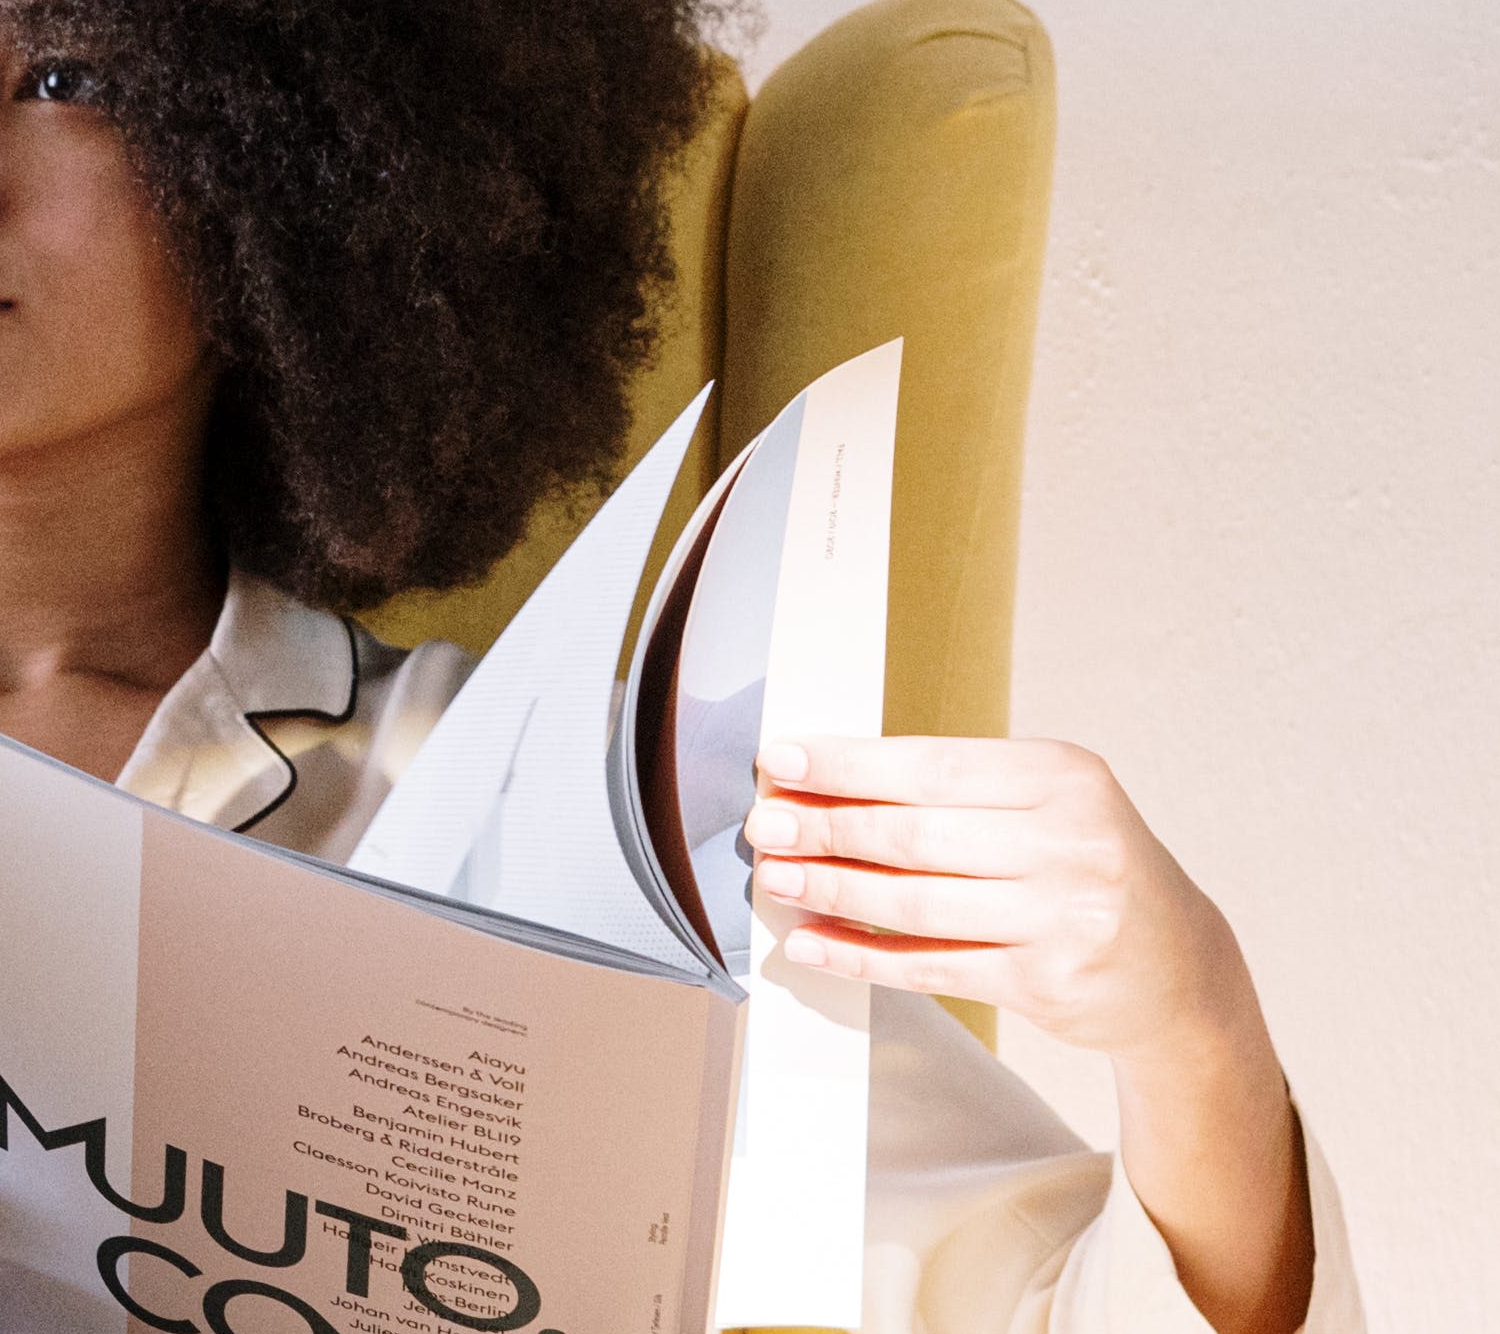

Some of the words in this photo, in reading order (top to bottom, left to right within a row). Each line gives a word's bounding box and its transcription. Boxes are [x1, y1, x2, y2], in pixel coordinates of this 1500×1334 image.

[336, 1044, 420, 1081] Andreas
[425, 1073, 525, 1111] Bergsaker
[360, 1034, 465, 1076] Anderssen
[469, 1068, 484, 1082] &
[489, 1073, 525, 1094] Voll
[468, 1050, 526, 1076] Aiayu
[348, 1067, 431, 1104] Andreas
[436, 1094, 523, 1130] Engesvik
[402, 1104, 469, 1132] Atelier
[297, 1104, 375, 1143] Broberg
[380, 1133, 394, 1147] &
[399, 1141, 519, 1183] Ridderstråle
[353, 1105, 445, 1144] Benjamin
[450, 1135, 520, 1165] Hubert
[292, 1140, 379, 1178] Claesson
[384, 1170, 461, 1203] Koivisto
[466, 1194, 517, 1217] Rune
[391, 1155, 457, 1184] Cecilie
[462, 1176, 518, 1200] Manz
[366, 1182, 423, 1210] David
[428, 1202, 516, 1235] Geckeler
[380, 1204, 445, 1234] Dimitri
[450, 1226, 515, 1253] Bähler
[423, 1271, 511, 1303] Koskinen
[330, 1295, 391, 1323] Johan
[395, 1315, 432, 1333] van
